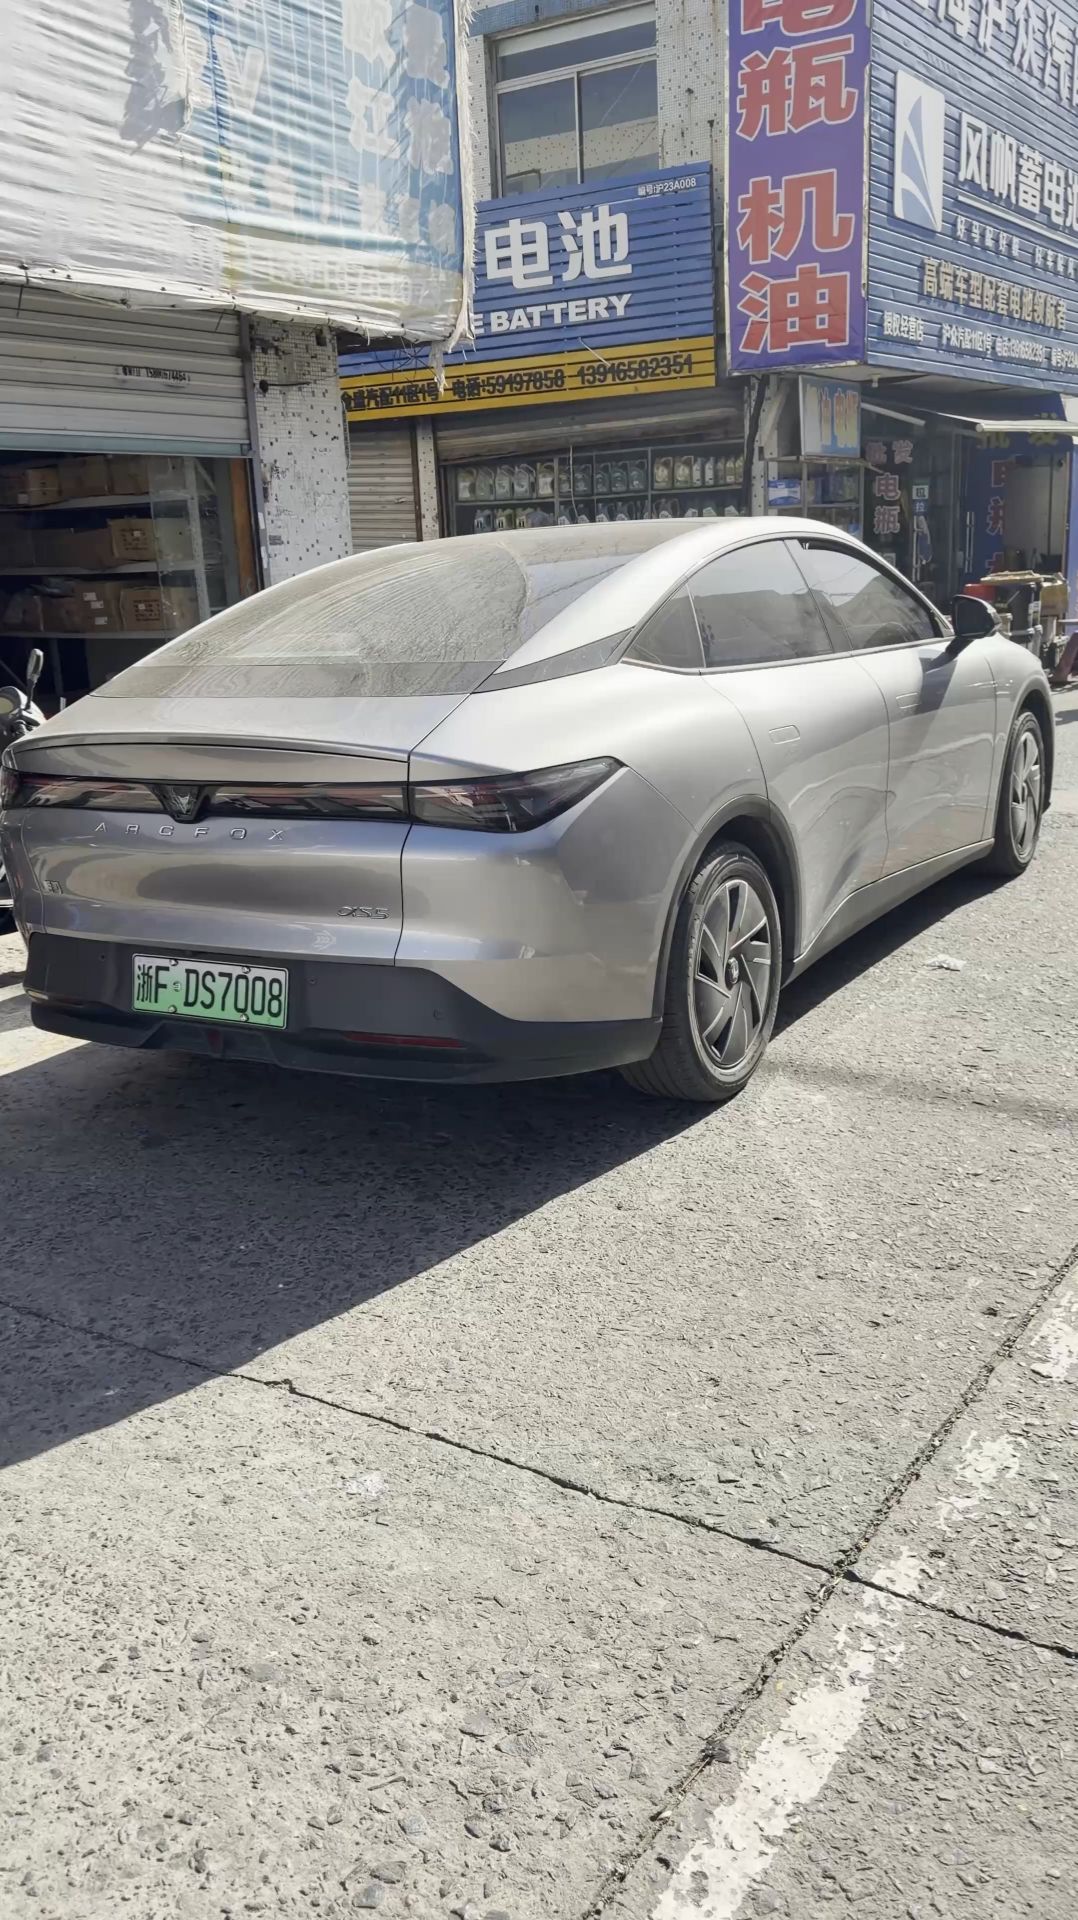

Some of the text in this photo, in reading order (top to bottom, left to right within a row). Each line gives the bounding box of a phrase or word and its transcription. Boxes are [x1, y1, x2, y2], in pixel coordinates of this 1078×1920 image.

[484, 204, 633, 289] 电池
[490, 293, 633, 332] BATTERY
[922, 256, 1067, 331] 高端车型配套电池领航者
[883, 310, 924, 342] 授权经营店
[576, 353, 693, 386] 13916582351
